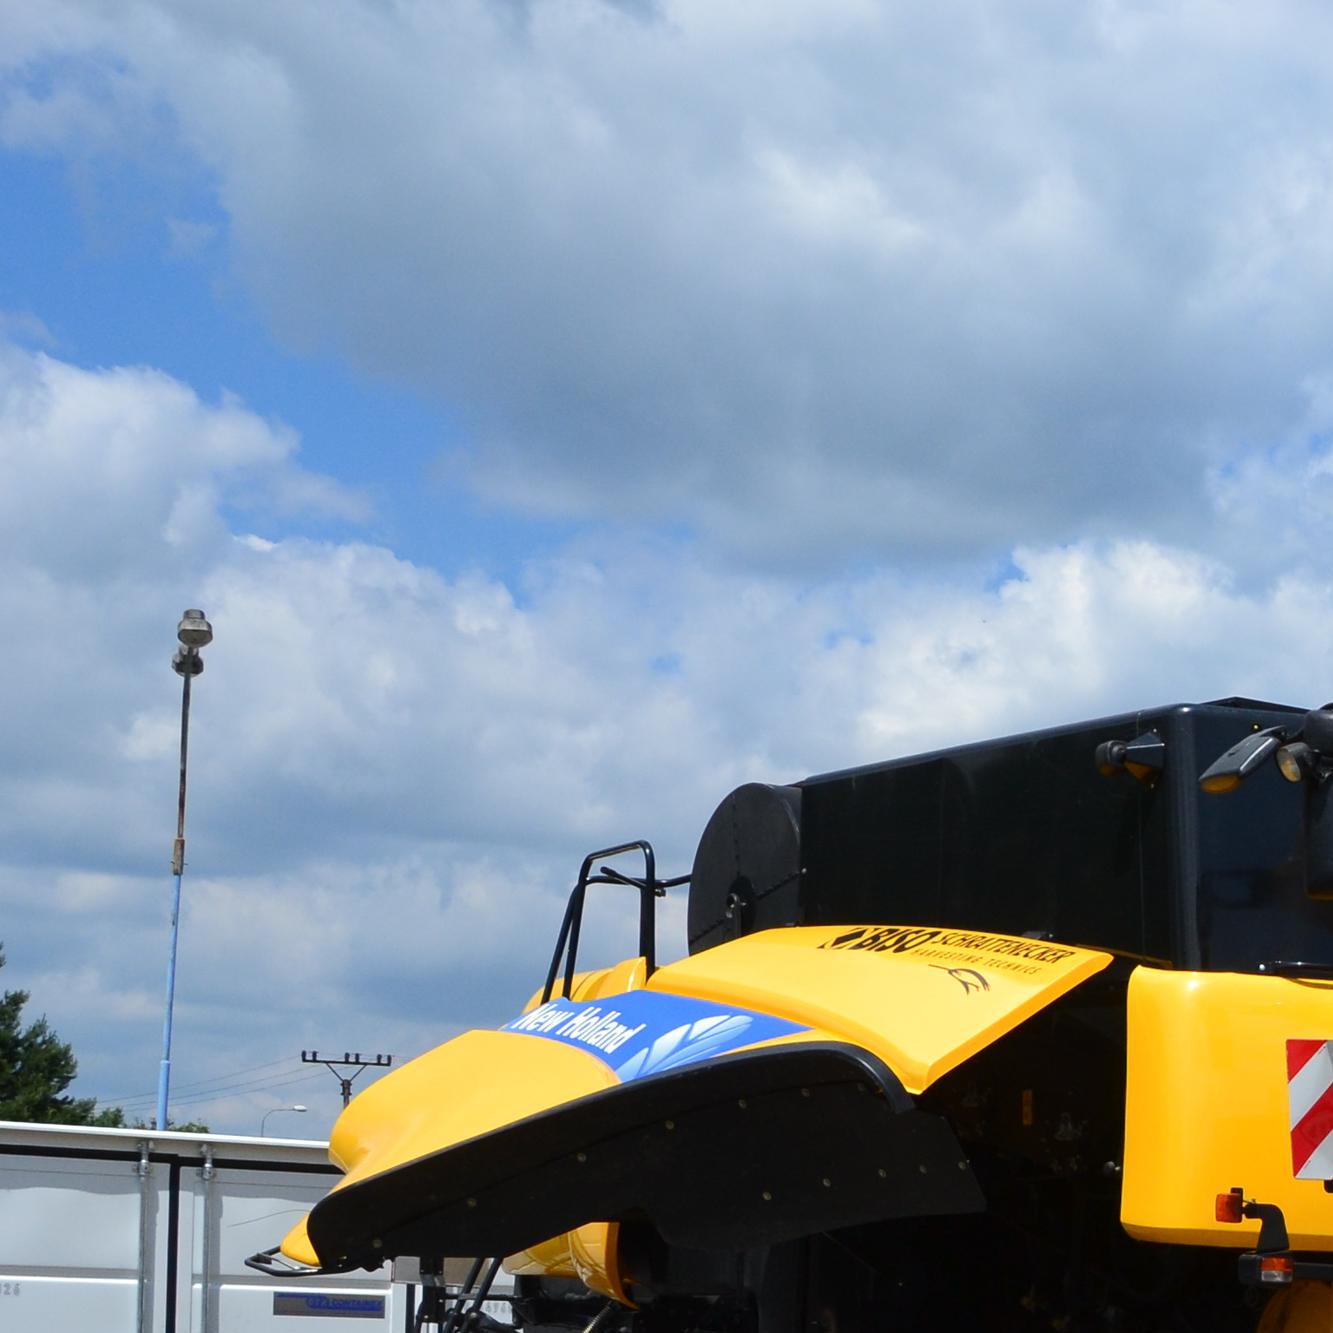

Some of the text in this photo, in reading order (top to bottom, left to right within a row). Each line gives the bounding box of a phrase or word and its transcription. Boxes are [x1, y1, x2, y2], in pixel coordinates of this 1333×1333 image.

[848, 928, 1077, 964] BISO SCHRATTENECKER
[510, 1003, 647, 1055] New Holland
